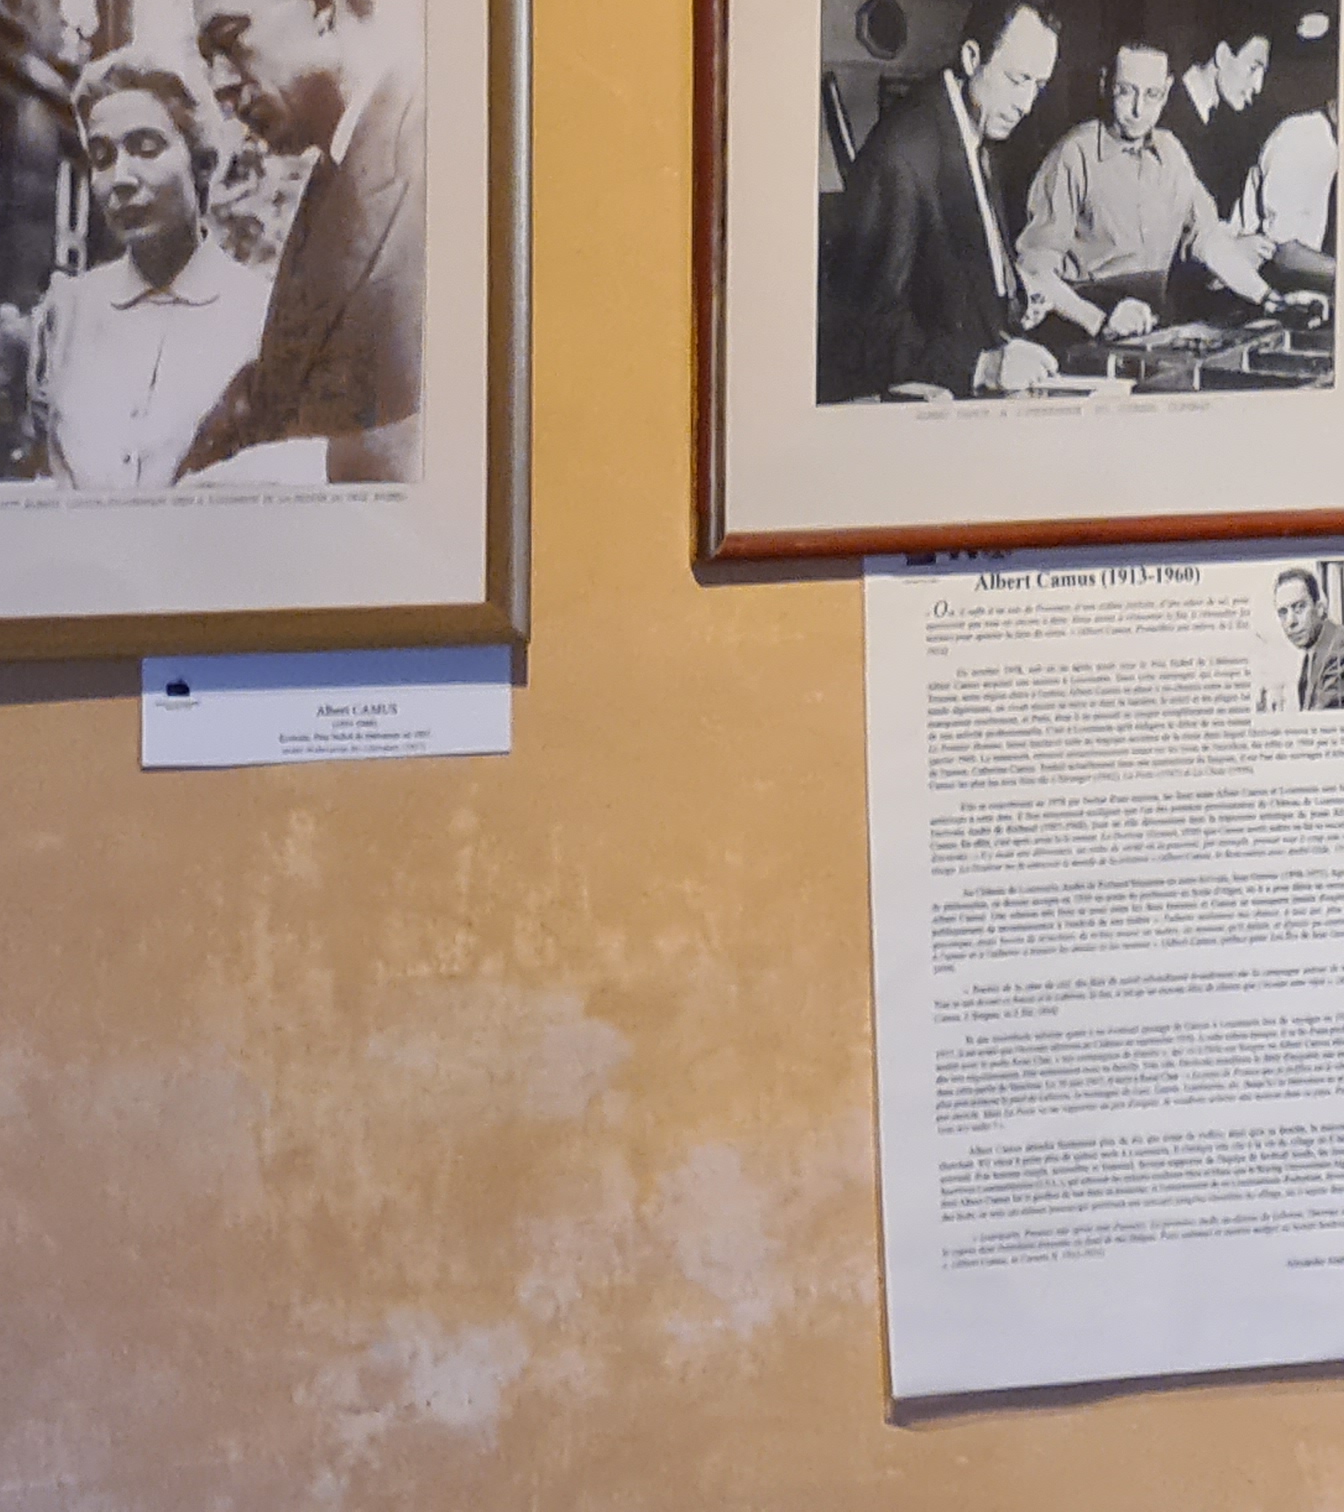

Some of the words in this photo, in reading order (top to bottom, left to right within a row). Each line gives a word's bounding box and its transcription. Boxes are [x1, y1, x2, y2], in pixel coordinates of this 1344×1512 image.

[975, 573, 1030, 591] Albert
[1037, 571, 1096, 588] Camus
[1101, 566, 1201, 589] (1913-1960)
